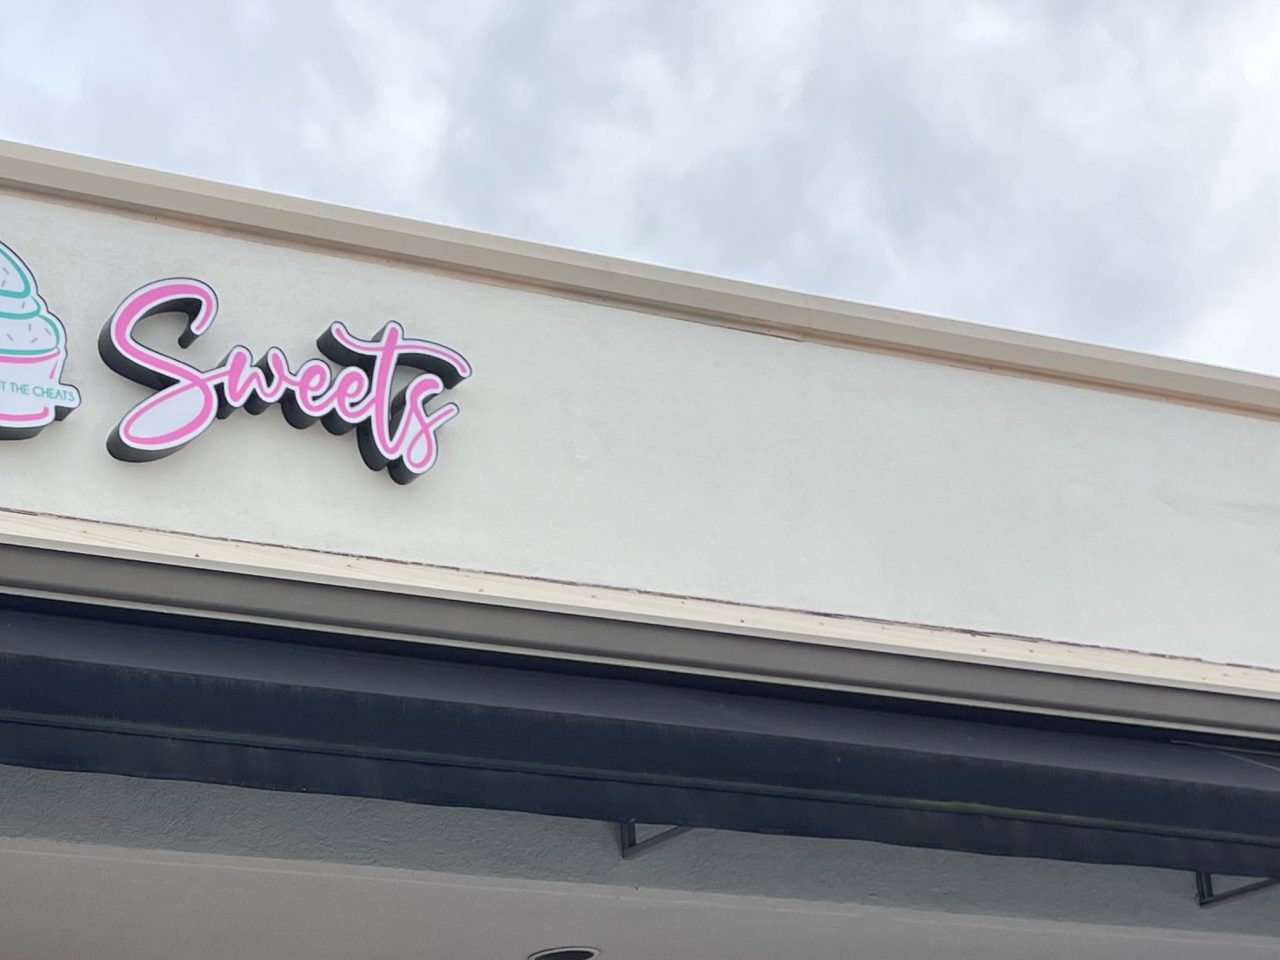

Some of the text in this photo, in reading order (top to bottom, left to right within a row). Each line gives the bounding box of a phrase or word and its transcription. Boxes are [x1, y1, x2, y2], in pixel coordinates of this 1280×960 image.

[10, 382, 30, 395] THE
[32, 386, 75, 401] CHEATS
[104, 278, 471, 476] Sweets
